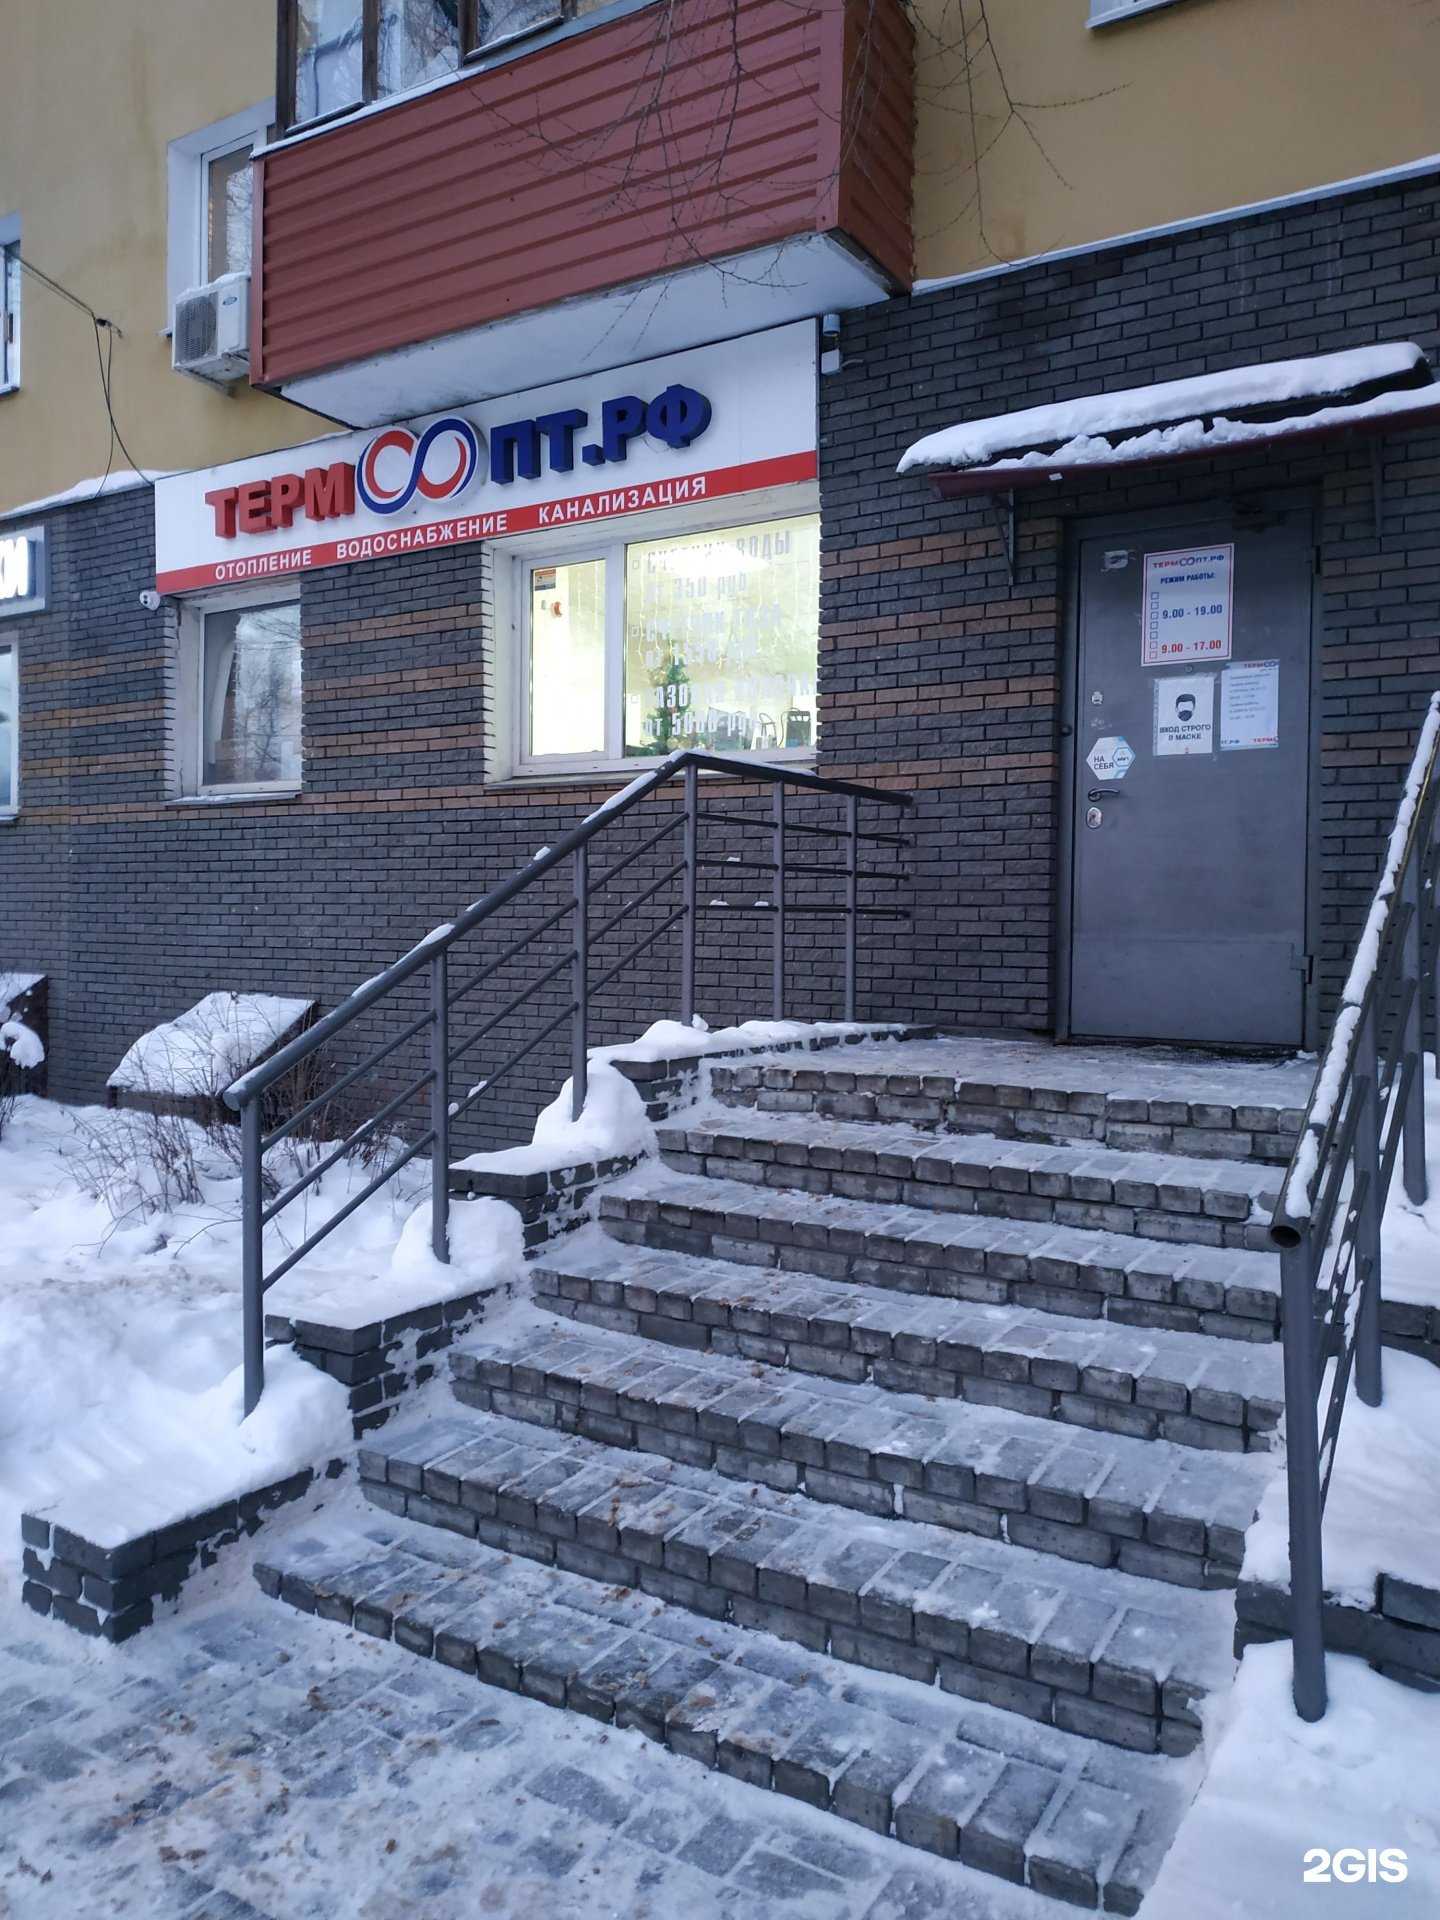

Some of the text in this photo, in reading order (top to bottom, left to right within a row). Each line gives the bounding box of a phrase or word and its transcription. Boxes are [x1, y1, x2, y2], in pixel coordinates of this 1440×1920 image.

[215, 476, 706, 580] ОТОПЛЕНИЕ ВОДОСНАБЖЕНИЕ КАНАЛИЗАЦИЯ
[1161, 575, 1185, 584] РЕЖИМ
[1162, 608, 1184, 619] 9.00
[1195, 604, 1223, 616] 19.00
[1161, 643, 1183, 654] 9.00
[1193, 639, 1222, 651] 17.00
[1159, 723, 1211, 734] ВХОД СТРОГО
[1176, 733, 1202, 741] МАСКЕ
[1093, 754, 1105, 763] НА
[1093, 762, 1114, 770] СЕБЯ
